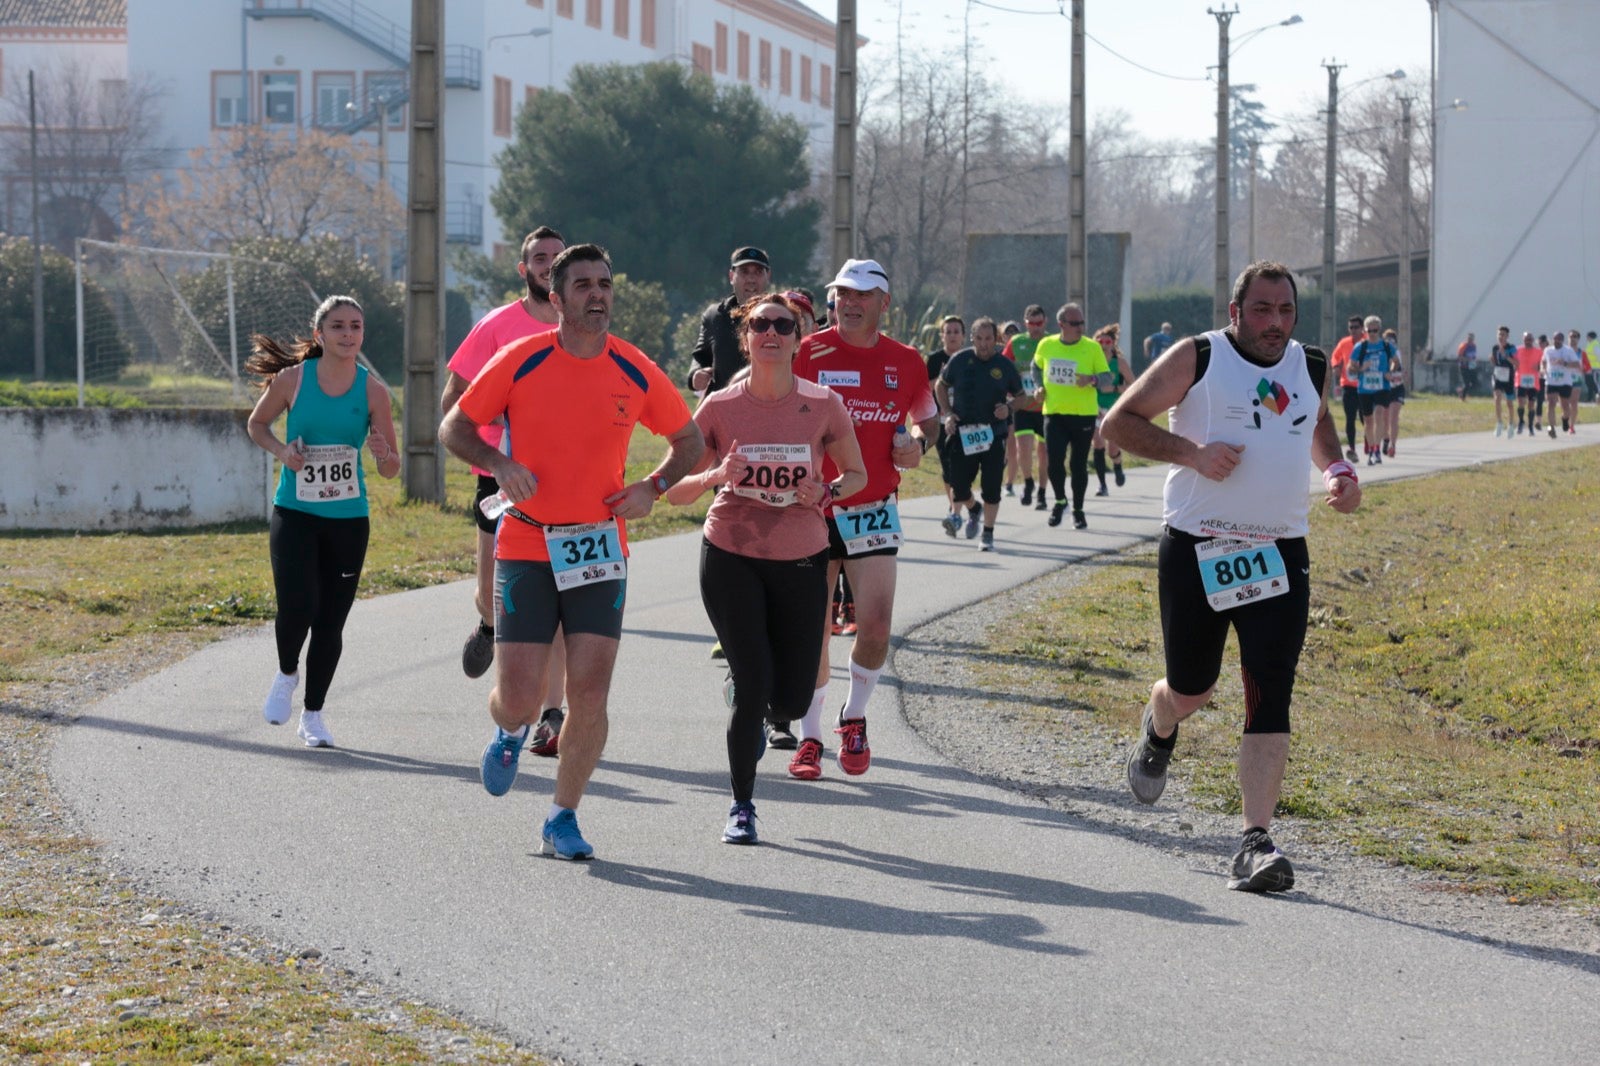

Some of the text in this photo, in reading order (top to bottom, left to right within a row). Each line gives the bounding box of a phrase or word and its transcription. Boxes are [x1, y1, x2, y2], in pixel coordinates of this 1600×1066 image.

[967, 430, 988, 445] 903
[304, 462, 352, 483] 3186
[738, 465, 807, 489] 2068
[847, 509, 892, 535] 722
[562, 533, 610, 564] 321
[1214, 551, 1269, 586] 801
